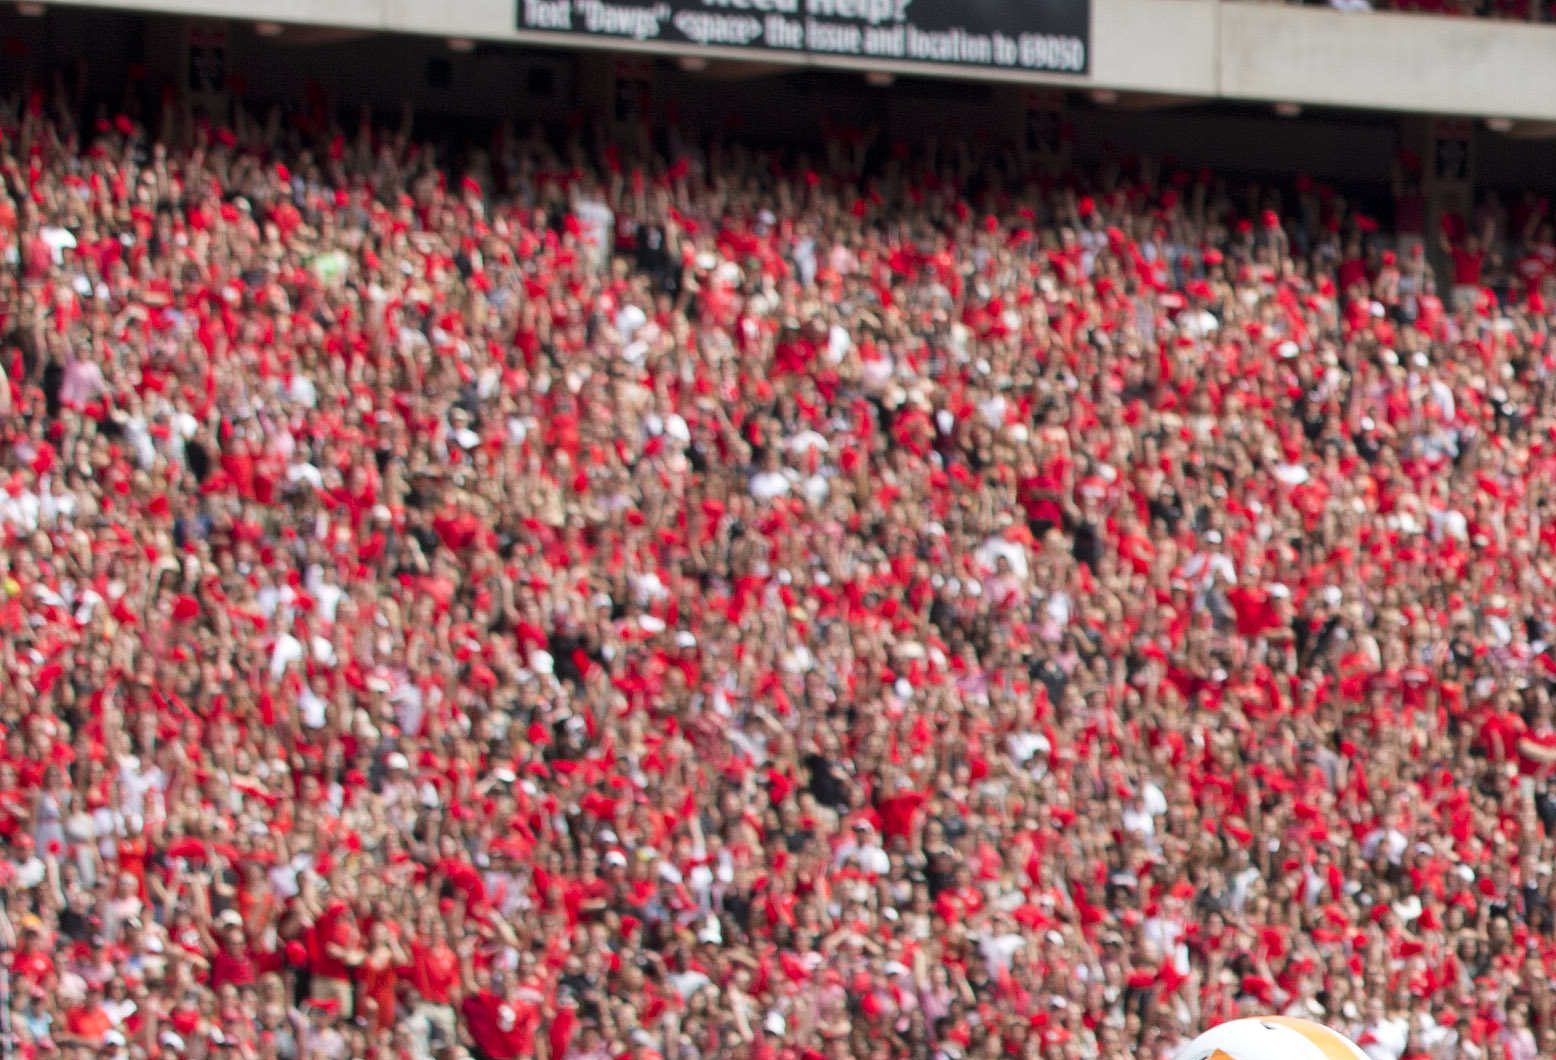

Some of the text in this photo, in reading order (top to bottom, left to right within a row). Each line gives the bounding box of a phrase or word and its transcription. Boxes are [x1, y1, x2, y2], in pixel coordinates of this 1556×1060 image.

[764, 13, 803, 49] the
[863, 22, 905, 57] and
[907, 23, 992, 62] location
[993, 30, 1017, 65] to
